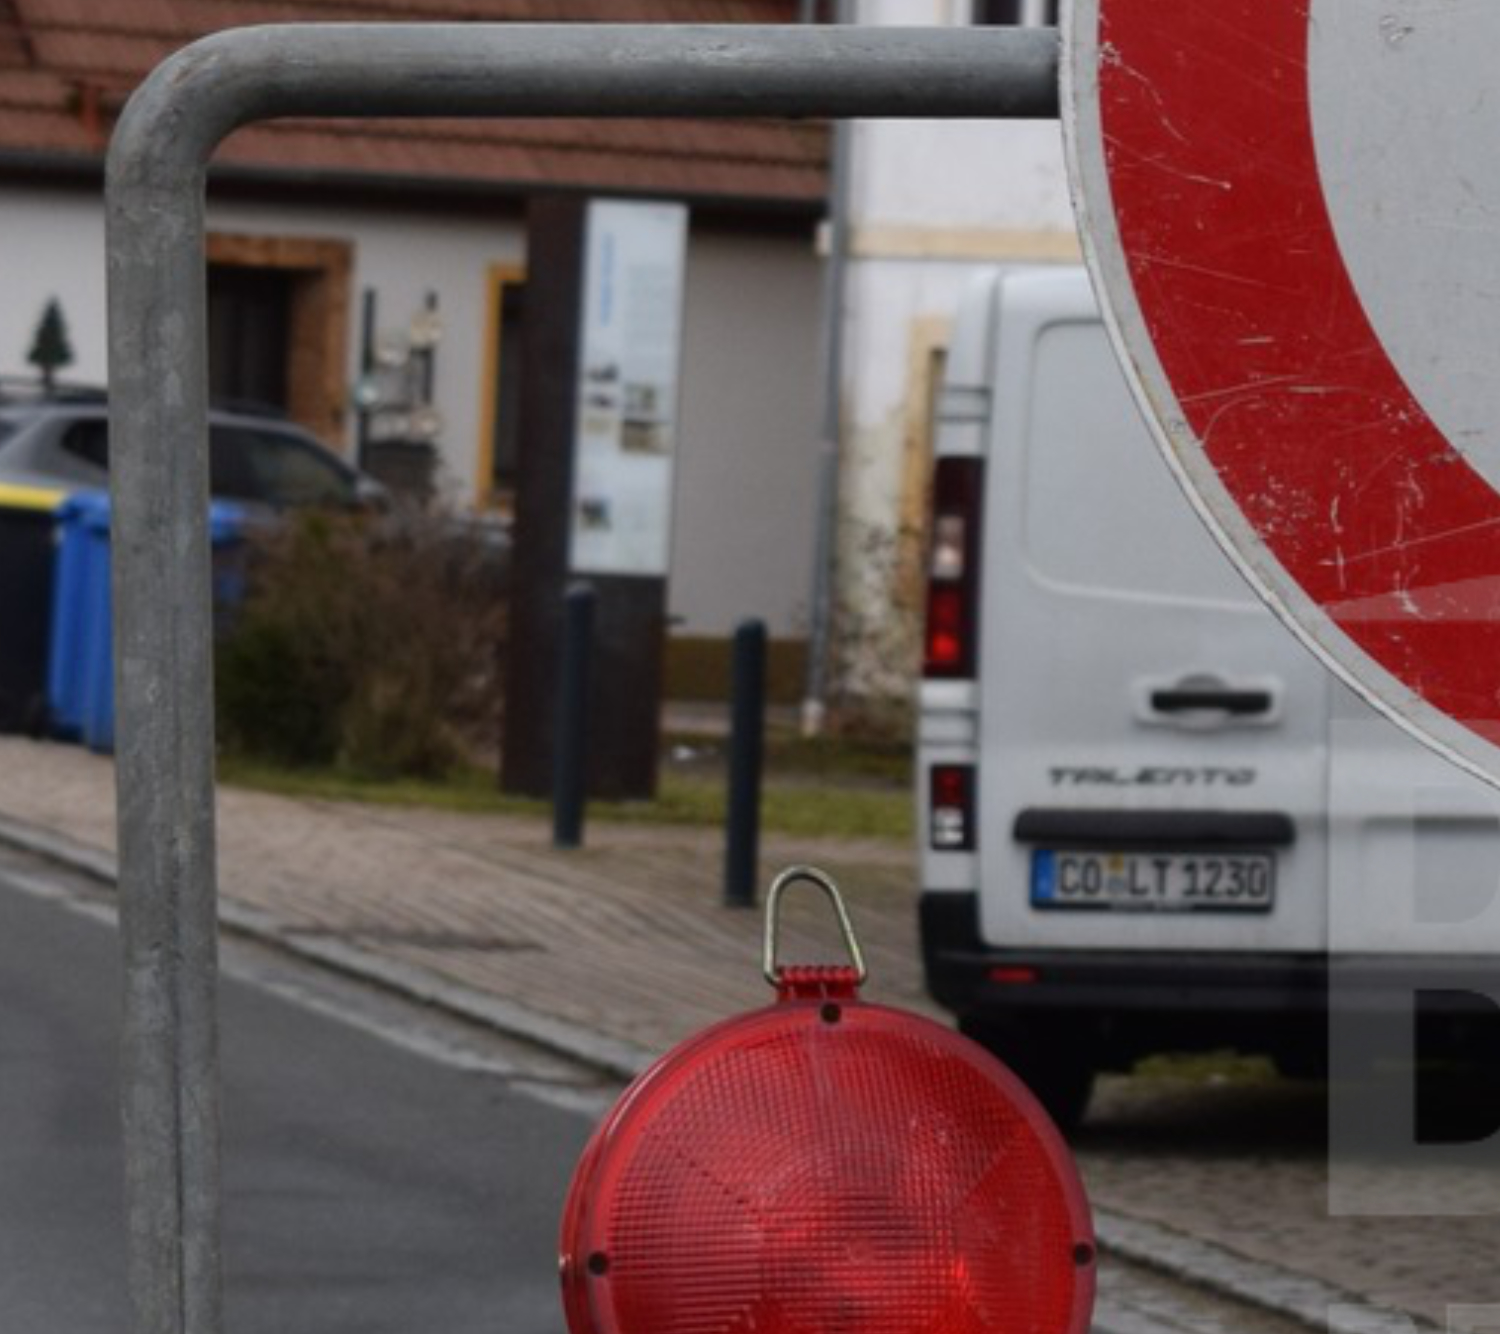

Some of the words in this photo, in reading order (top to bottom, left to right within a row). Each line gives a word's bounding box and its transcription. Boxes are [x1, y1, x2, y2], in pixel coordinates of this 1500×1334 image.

[1048, 766, 1258, 787] TALENTO
[1059, 857, 1102, 897] CO
[1128, 858, 1171, 896] LT
[1182, 860, 1268, 898] 1230
